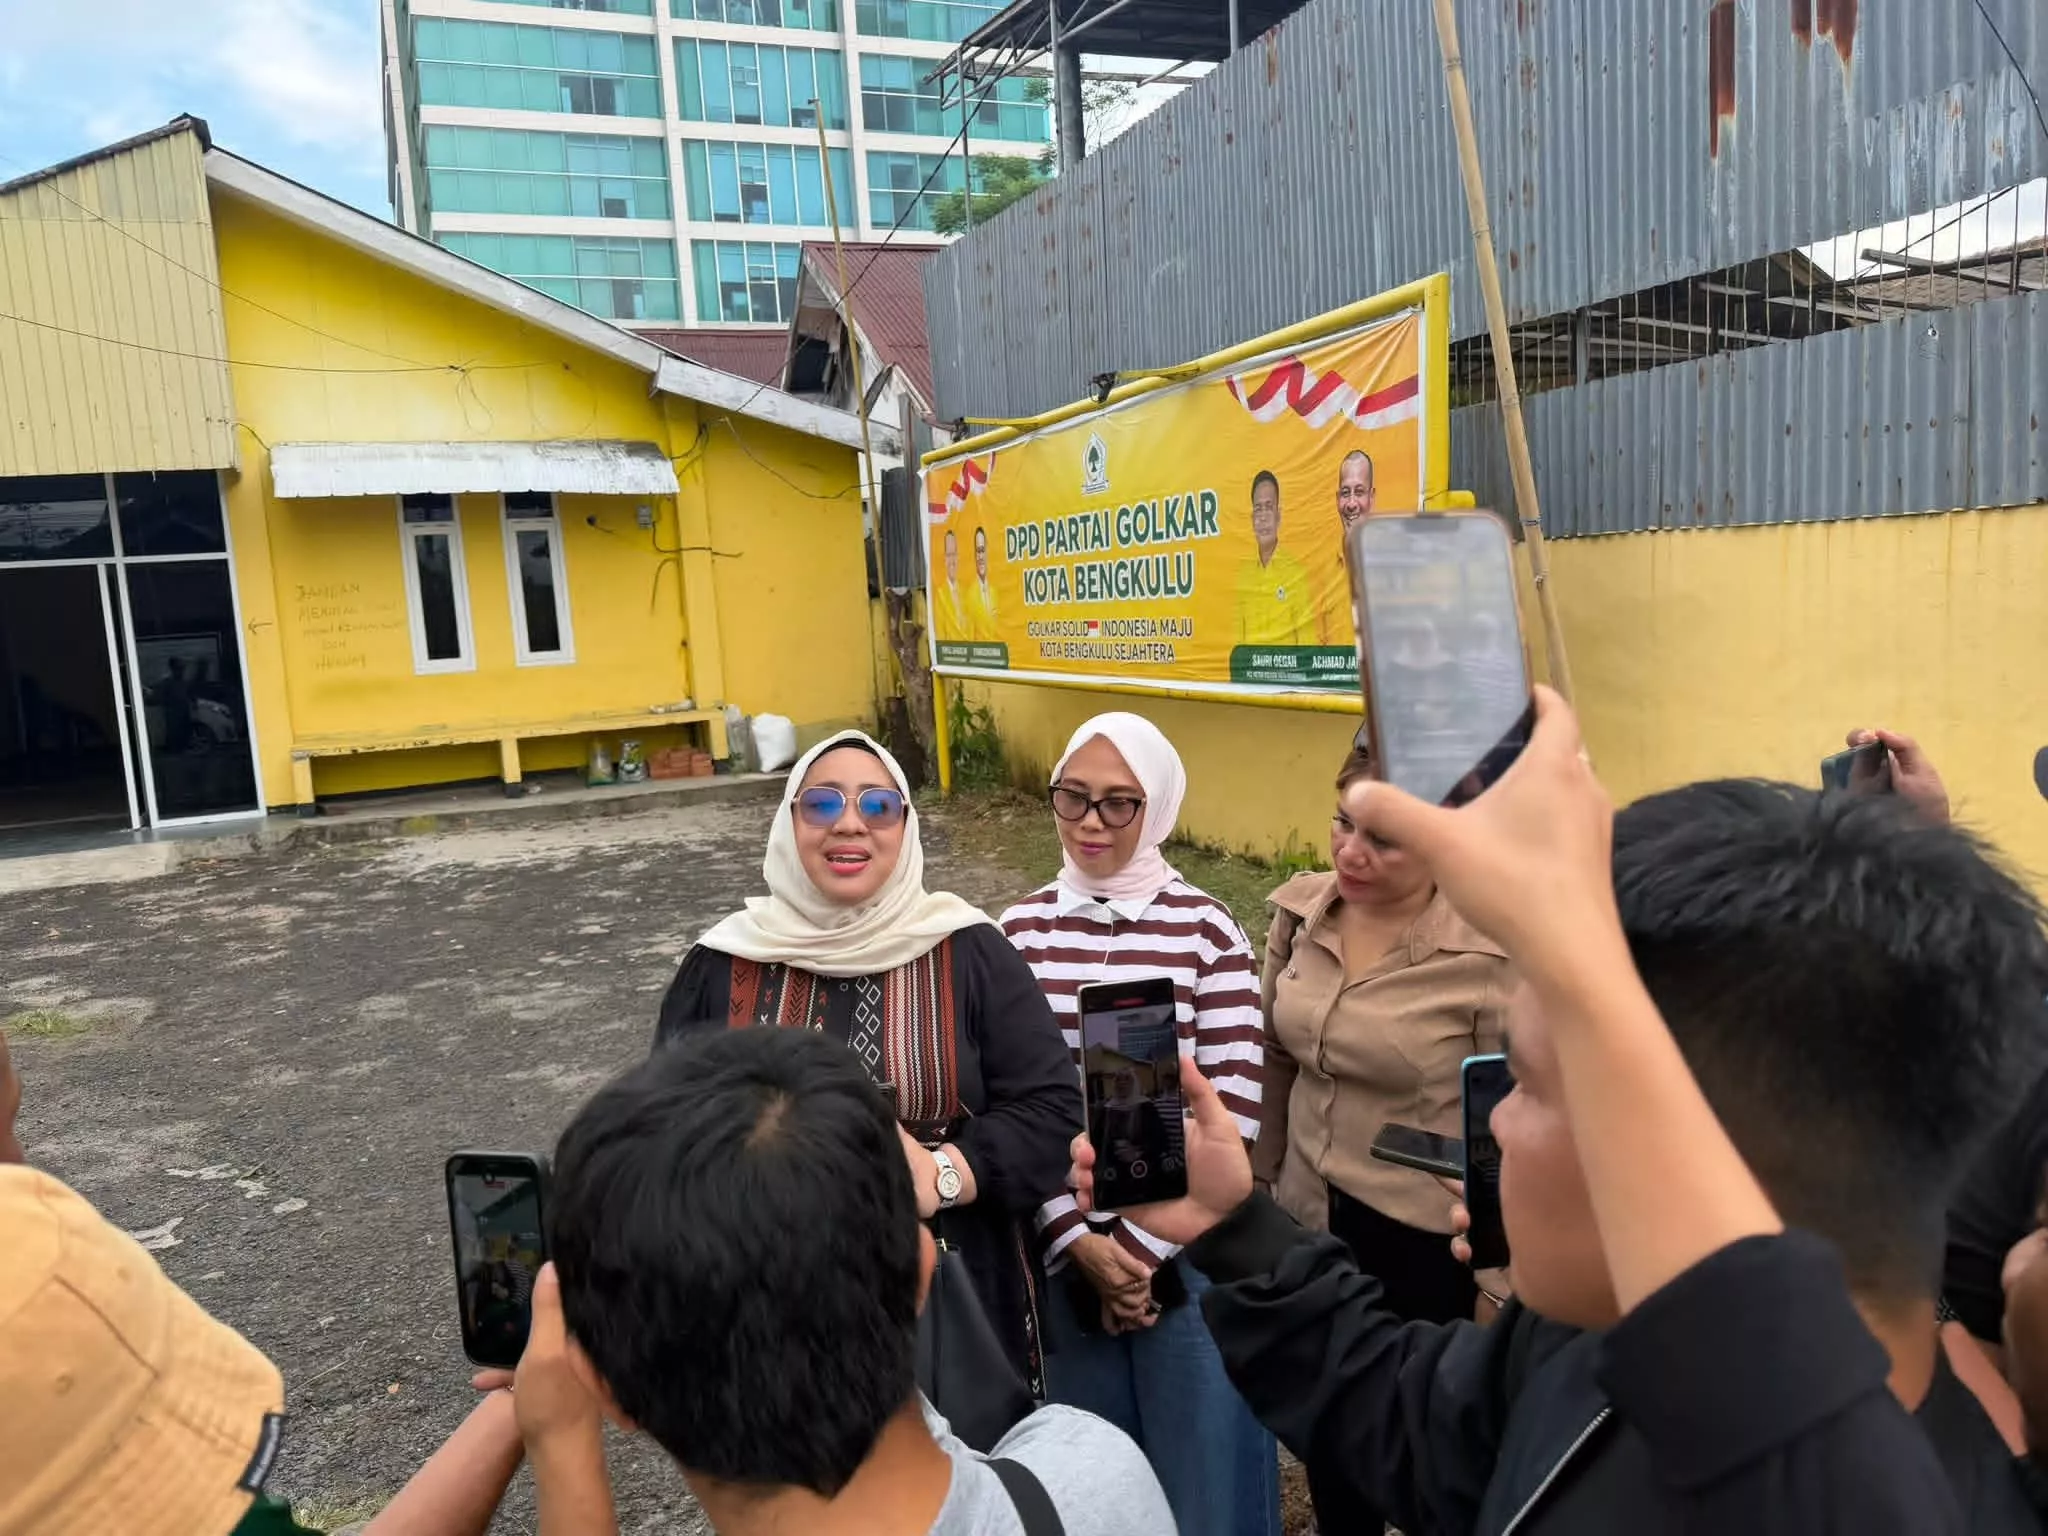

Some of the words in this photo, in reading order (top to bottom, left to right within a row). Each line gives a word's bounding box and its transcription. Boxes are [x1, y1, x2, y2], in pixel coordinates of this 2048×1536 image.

[1006, 525, 1040, 560] DPD
[1044, 511, 1110, 555] PARTAI
[1116, 490, 1218, 546] GOLKAR
[1024, 567, 1070, 603] KOTA
[1075, 553, 1194, 600] BENGKULU
[1027, 621, 1062, 637] GOLKAR
[1063, 621, 1089, 637] SOLID
[1101, 619, 1157, 637] INDONESIA
[1159, 618, 1193, 637] MAJU
[1040, 642, 1062, 657] KOTA
[1064, 642, 1113, 659] BENGKULU
[1114, 643, 1175, 662] SEJAHTERA
[1312, 655, 1344, 668] ACHMAD
